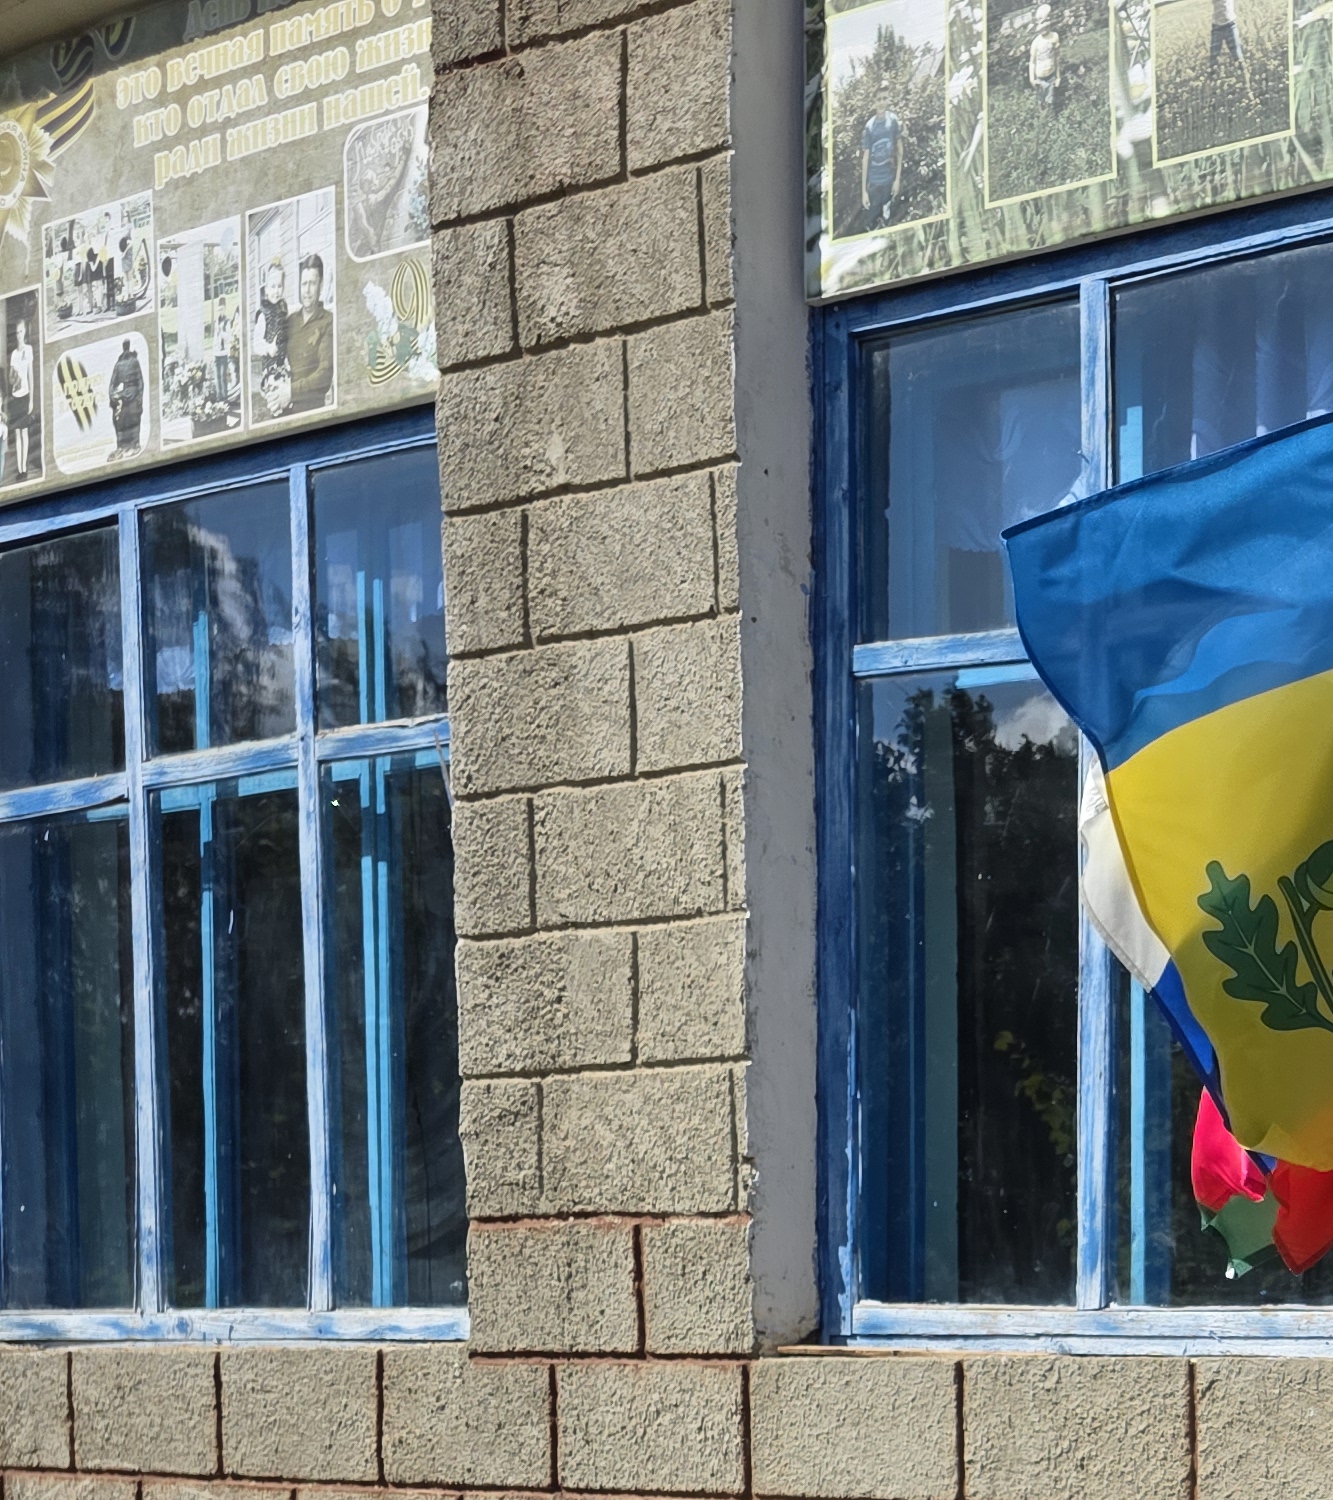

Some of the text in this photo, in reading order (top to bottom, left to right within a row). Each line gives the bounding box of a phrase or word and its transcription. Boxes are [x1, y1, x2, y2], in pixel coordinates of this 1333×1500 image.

[116, 66, 162, 109] это
[166, 29, 264, 93] вечная
[269, 0, 375, 56] память
[133, 17, 433, 148] кто отдал свою жизн
[154, 134, 221, 190] ради
[227, 102, 318, 161] жизни
[324, 63, 431, 130] нашей.
